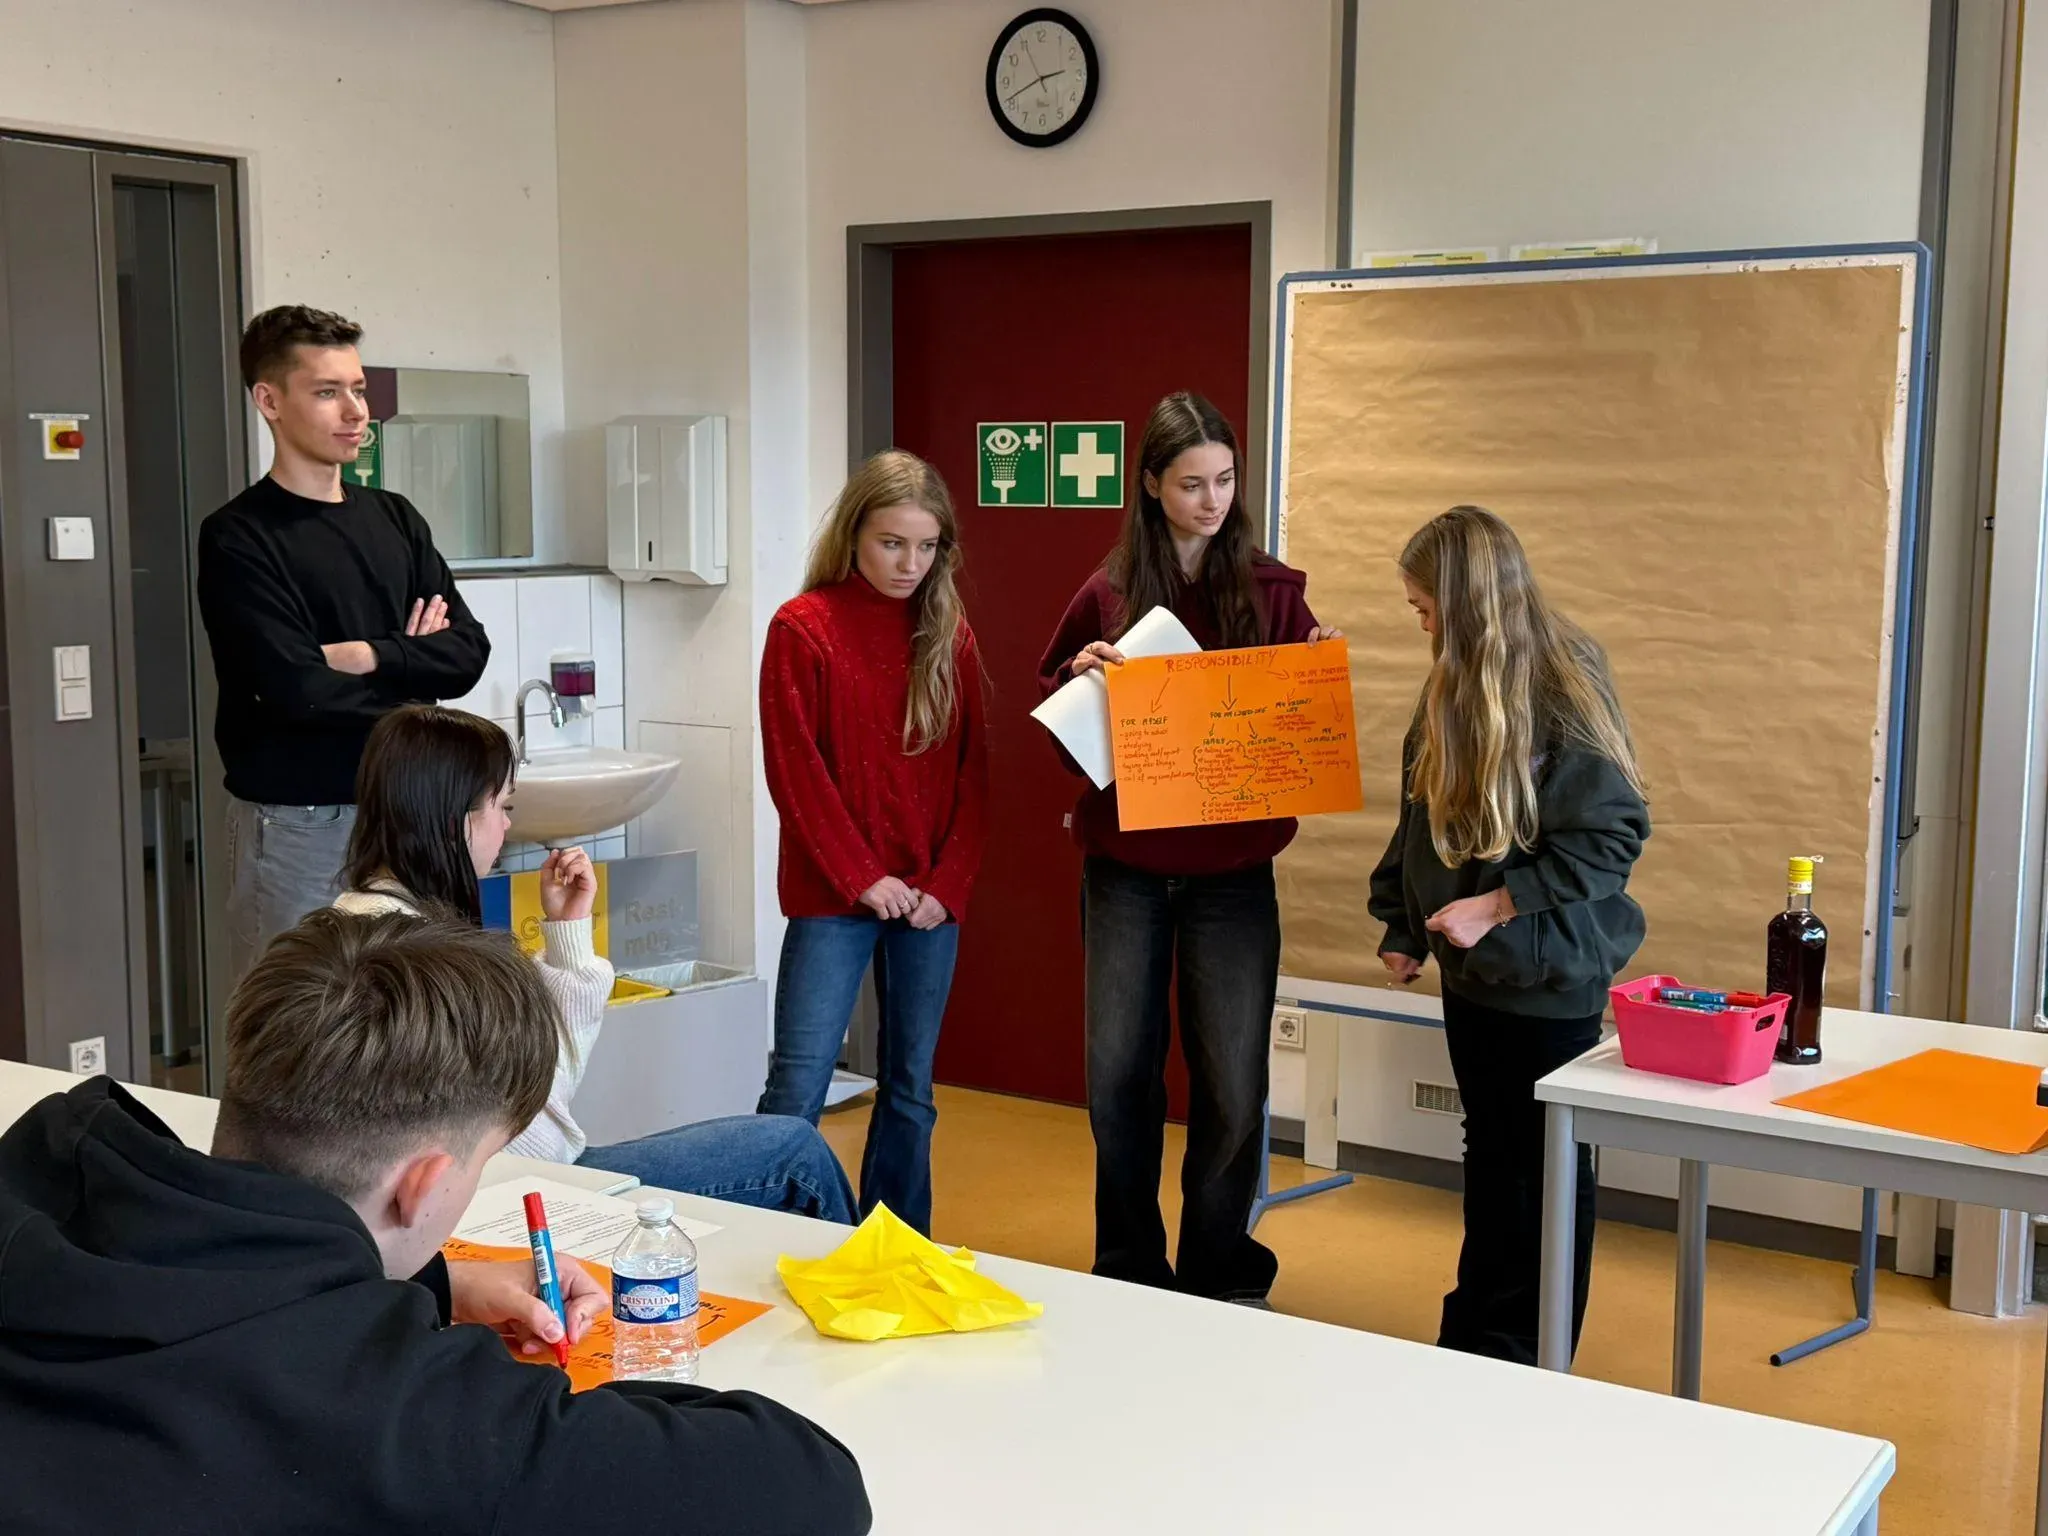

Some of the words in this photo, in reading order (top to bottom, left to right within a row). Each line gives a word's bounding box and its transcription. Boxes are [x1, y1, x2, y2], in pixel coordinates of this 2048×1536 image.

[1036, 29, 1047, 43] 12
[1069, 46, 1077, 61] 2
[1009, 54, 1019, 67] 10
[1076, 69, 1082, 82] 3
[1002, 76, 1010, 89] 9
[1069, 91, 1076, 102] 4
[1022, 111, 1029, 124] 7
[1039, 113, 1046, 127] 6
[1057, 107, 1064, 120] 5
[1165, 649, 1278, 673] RESPONSIBILITY
[1120, 718, 1136, 728] FOR
[1142, 715, 1168, 726] MYSELF
[621, 1295, 675, 1305] CRISTALINE
